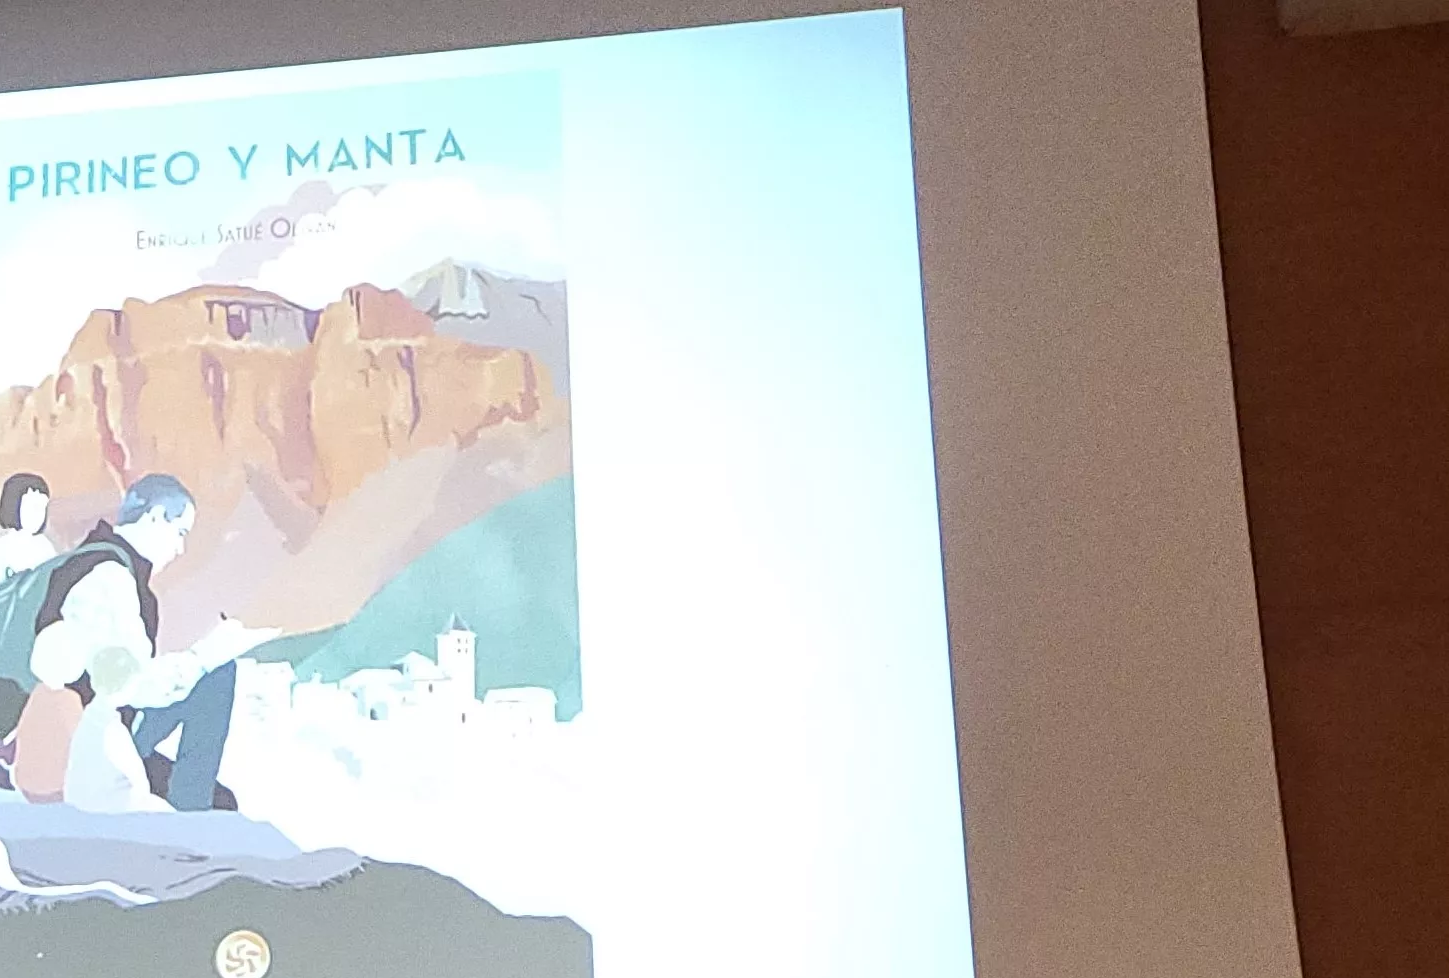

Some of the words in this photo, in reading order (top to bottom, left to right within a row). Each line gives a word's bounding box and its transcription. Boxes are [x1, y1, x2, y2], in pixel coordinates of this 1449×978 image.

[8, 150, 201, 203] PIRINEO
[228, 143, 259, 181] Y
[286, 127, 466, 177] MANTA
